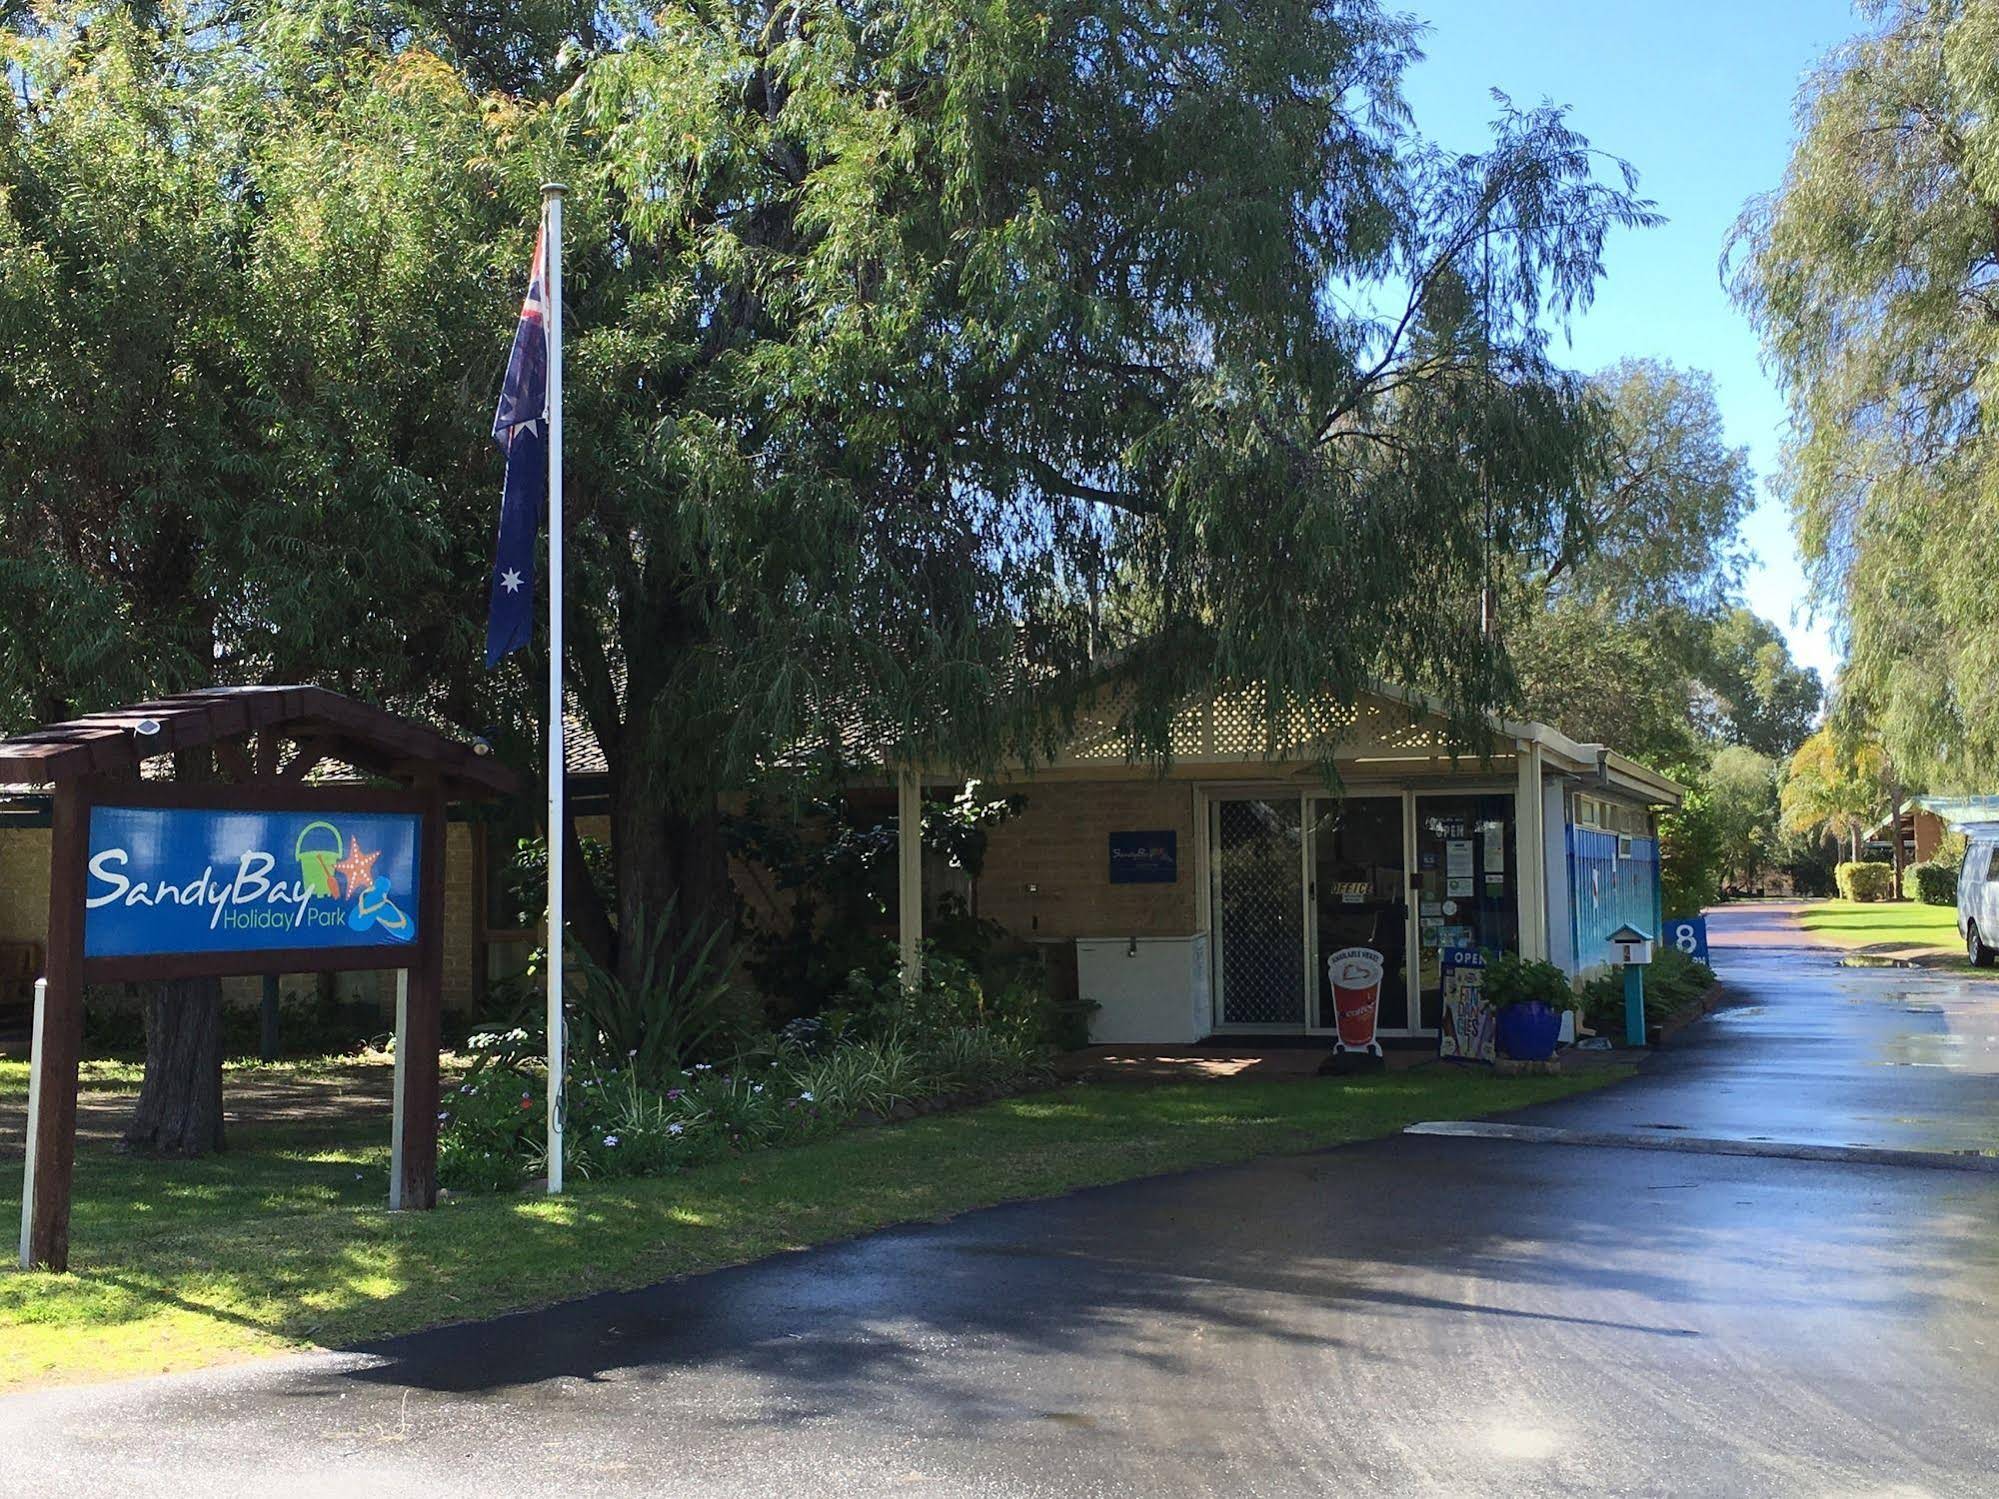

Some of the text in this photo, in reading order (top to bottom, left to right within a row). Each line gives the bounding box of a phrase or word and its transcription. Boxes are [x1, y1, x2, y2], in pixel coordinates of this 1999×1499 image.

[223, 906, 346, 932] Holiday Park
[1675, 924, 1697, 954] 8
